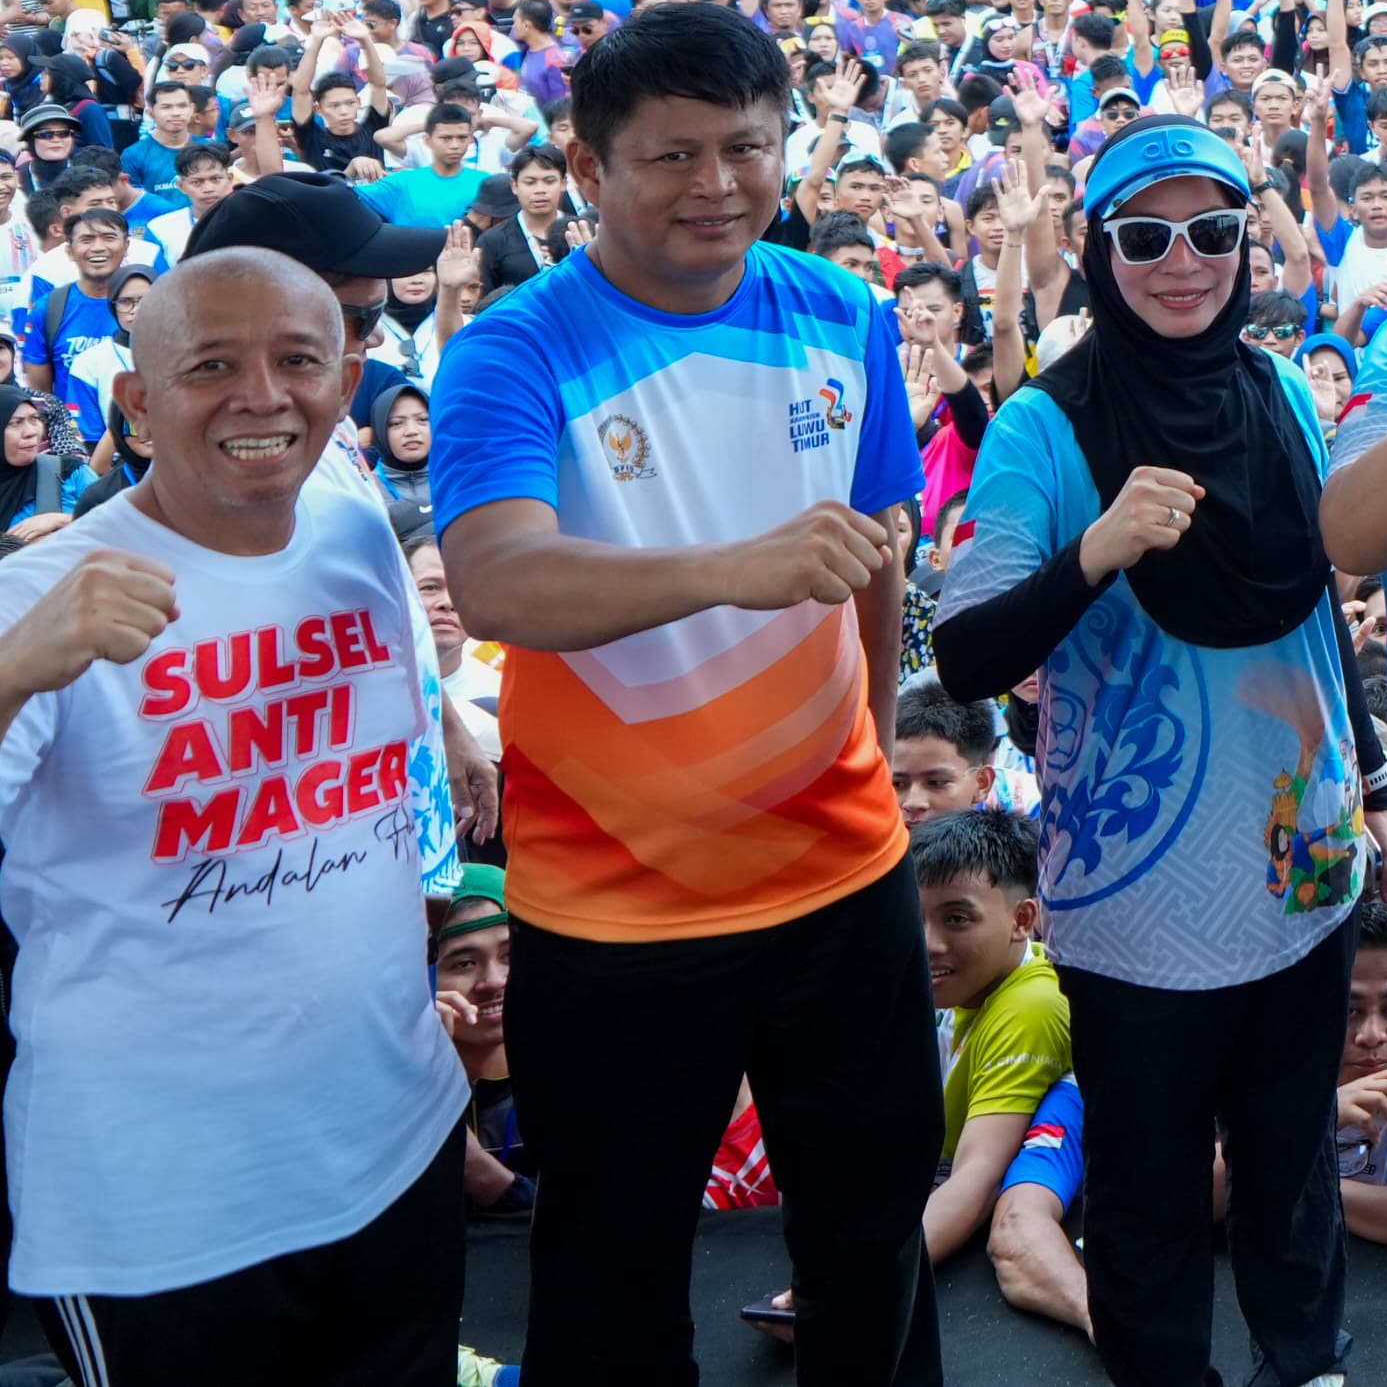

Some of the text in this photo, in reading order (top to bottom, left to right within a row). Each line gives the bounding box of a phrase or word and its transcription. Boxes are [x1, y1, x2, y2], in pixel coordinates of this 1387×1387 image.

[789, 399, 812, 416] HUT
[789, 419, 826, 439] LUWU
[791, 432, 830, 453] TIMUR
[140, 609, 391, 717] SULSEL
[143, 684, 354, 795] ANTI
[152, 739, 410, 862] MAGER
[161, 837, 367, 924] Andalan
